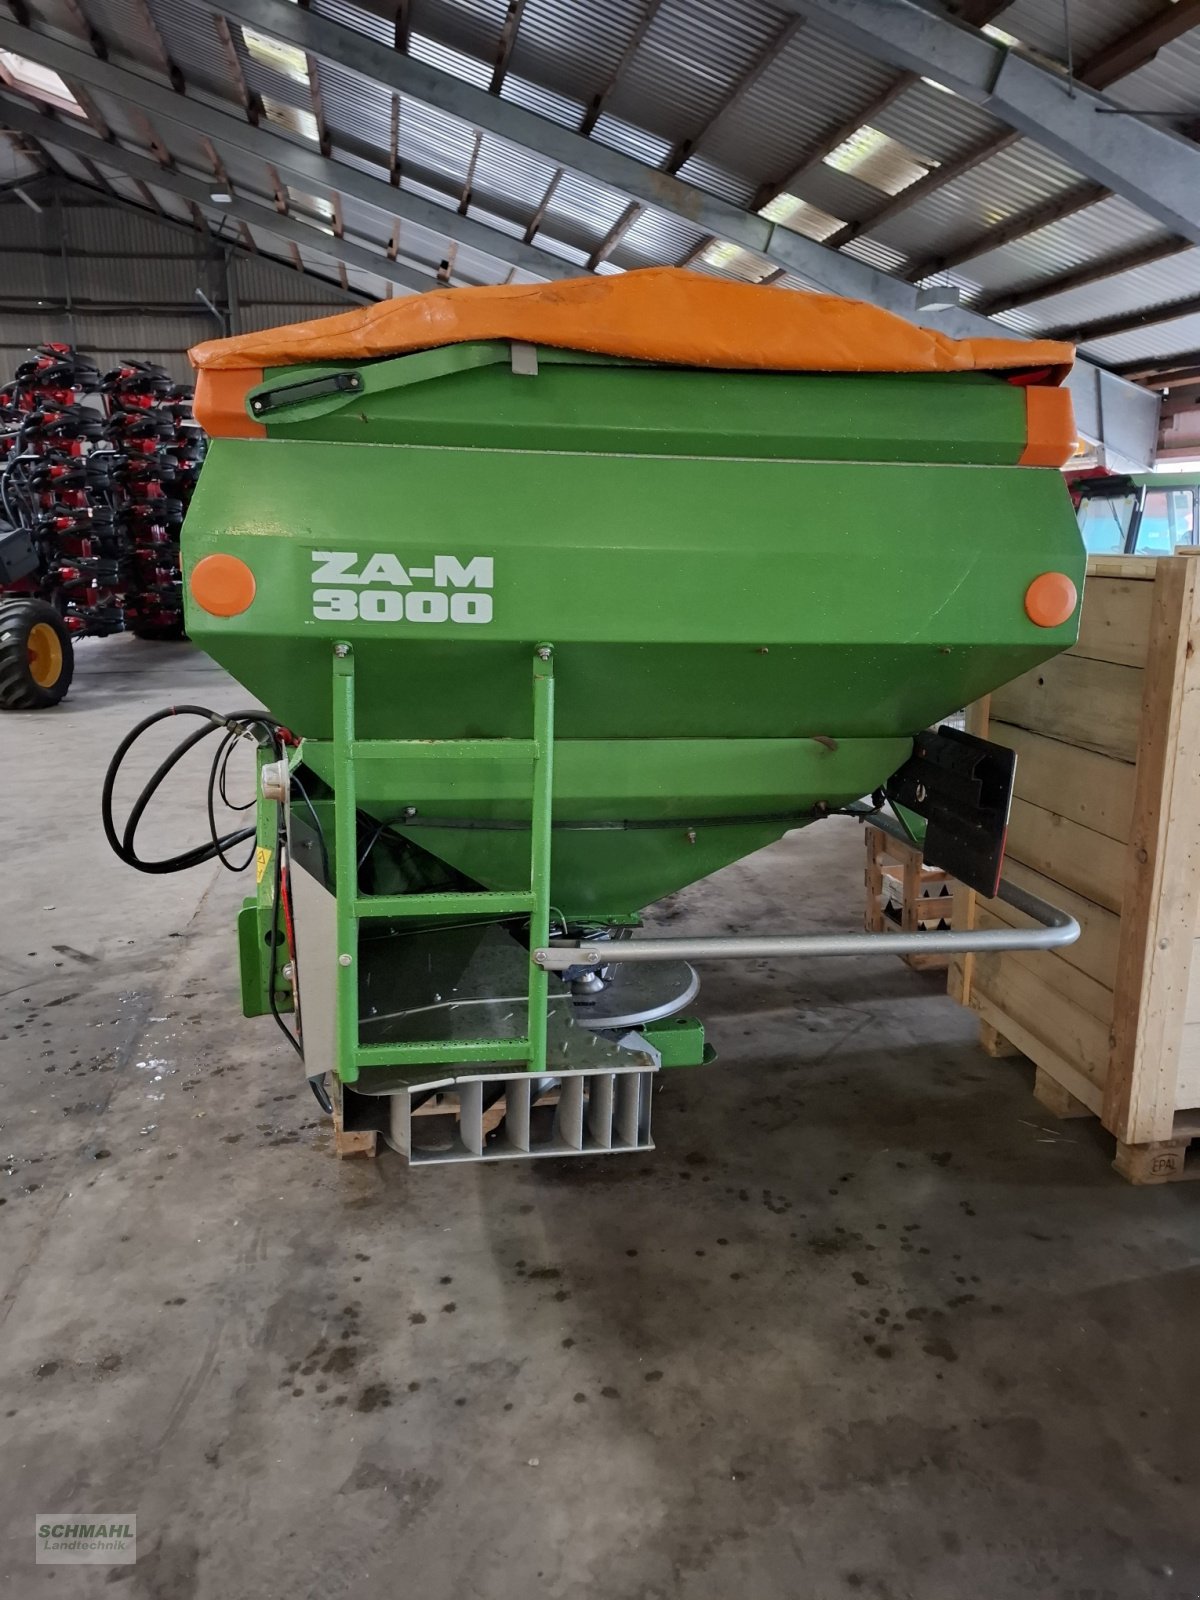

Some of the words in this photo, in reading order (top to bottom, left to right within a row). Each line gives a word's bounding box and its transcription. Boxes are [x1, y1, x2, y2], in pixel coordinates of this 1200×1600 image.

[311, 551, 494, 588] ZA-M
[312, 588, 493, 624] 3000
[1152, 1158, 1176, 1172] EPAL
